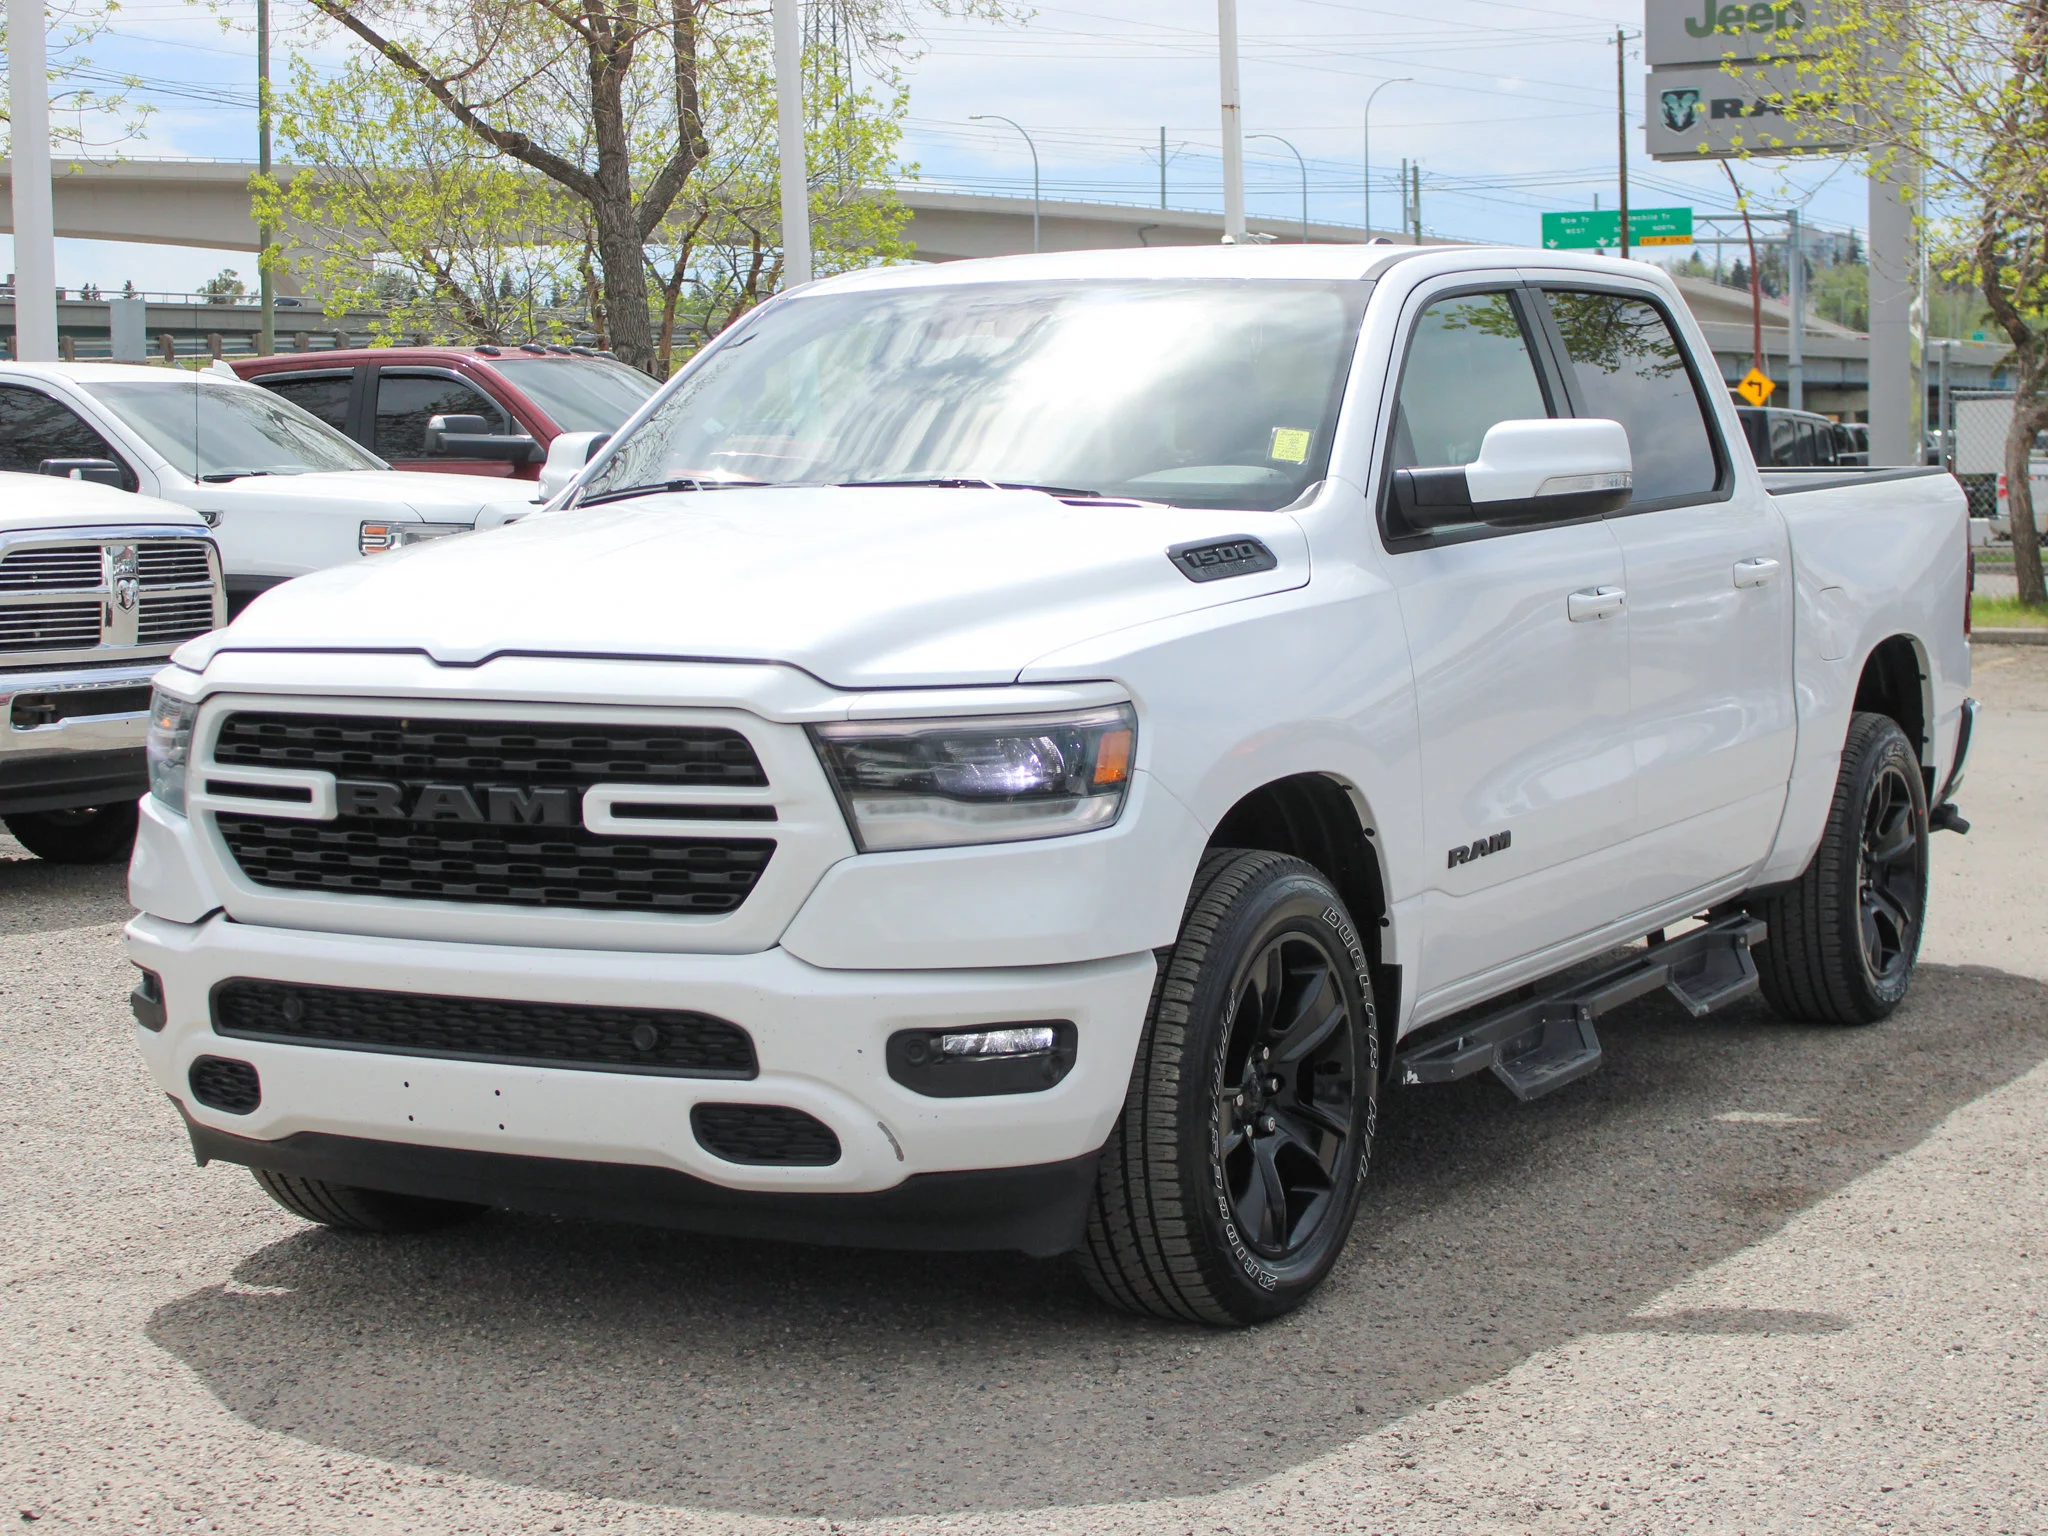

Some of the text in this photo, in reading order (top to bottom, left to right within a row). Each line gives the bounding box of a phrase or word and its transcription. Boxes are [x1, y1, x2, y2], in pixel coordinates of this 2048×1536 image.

[1684, 0, 1807, 41] Jeep
[1711, 92, 1838, 119] RA
[1614, 225, 1636, 233] SOTH
[1617, 213, 1658, 222] Cowchild
[1187, 543, 1256, 567] 1500
[336, 779, 571, 826] RAM
[1447, 829, 1511, 869] RAM
[1322, 906, 1378, 1070] DUELER
[1209, 988, 1278, 1291] BRIDGESTONE
